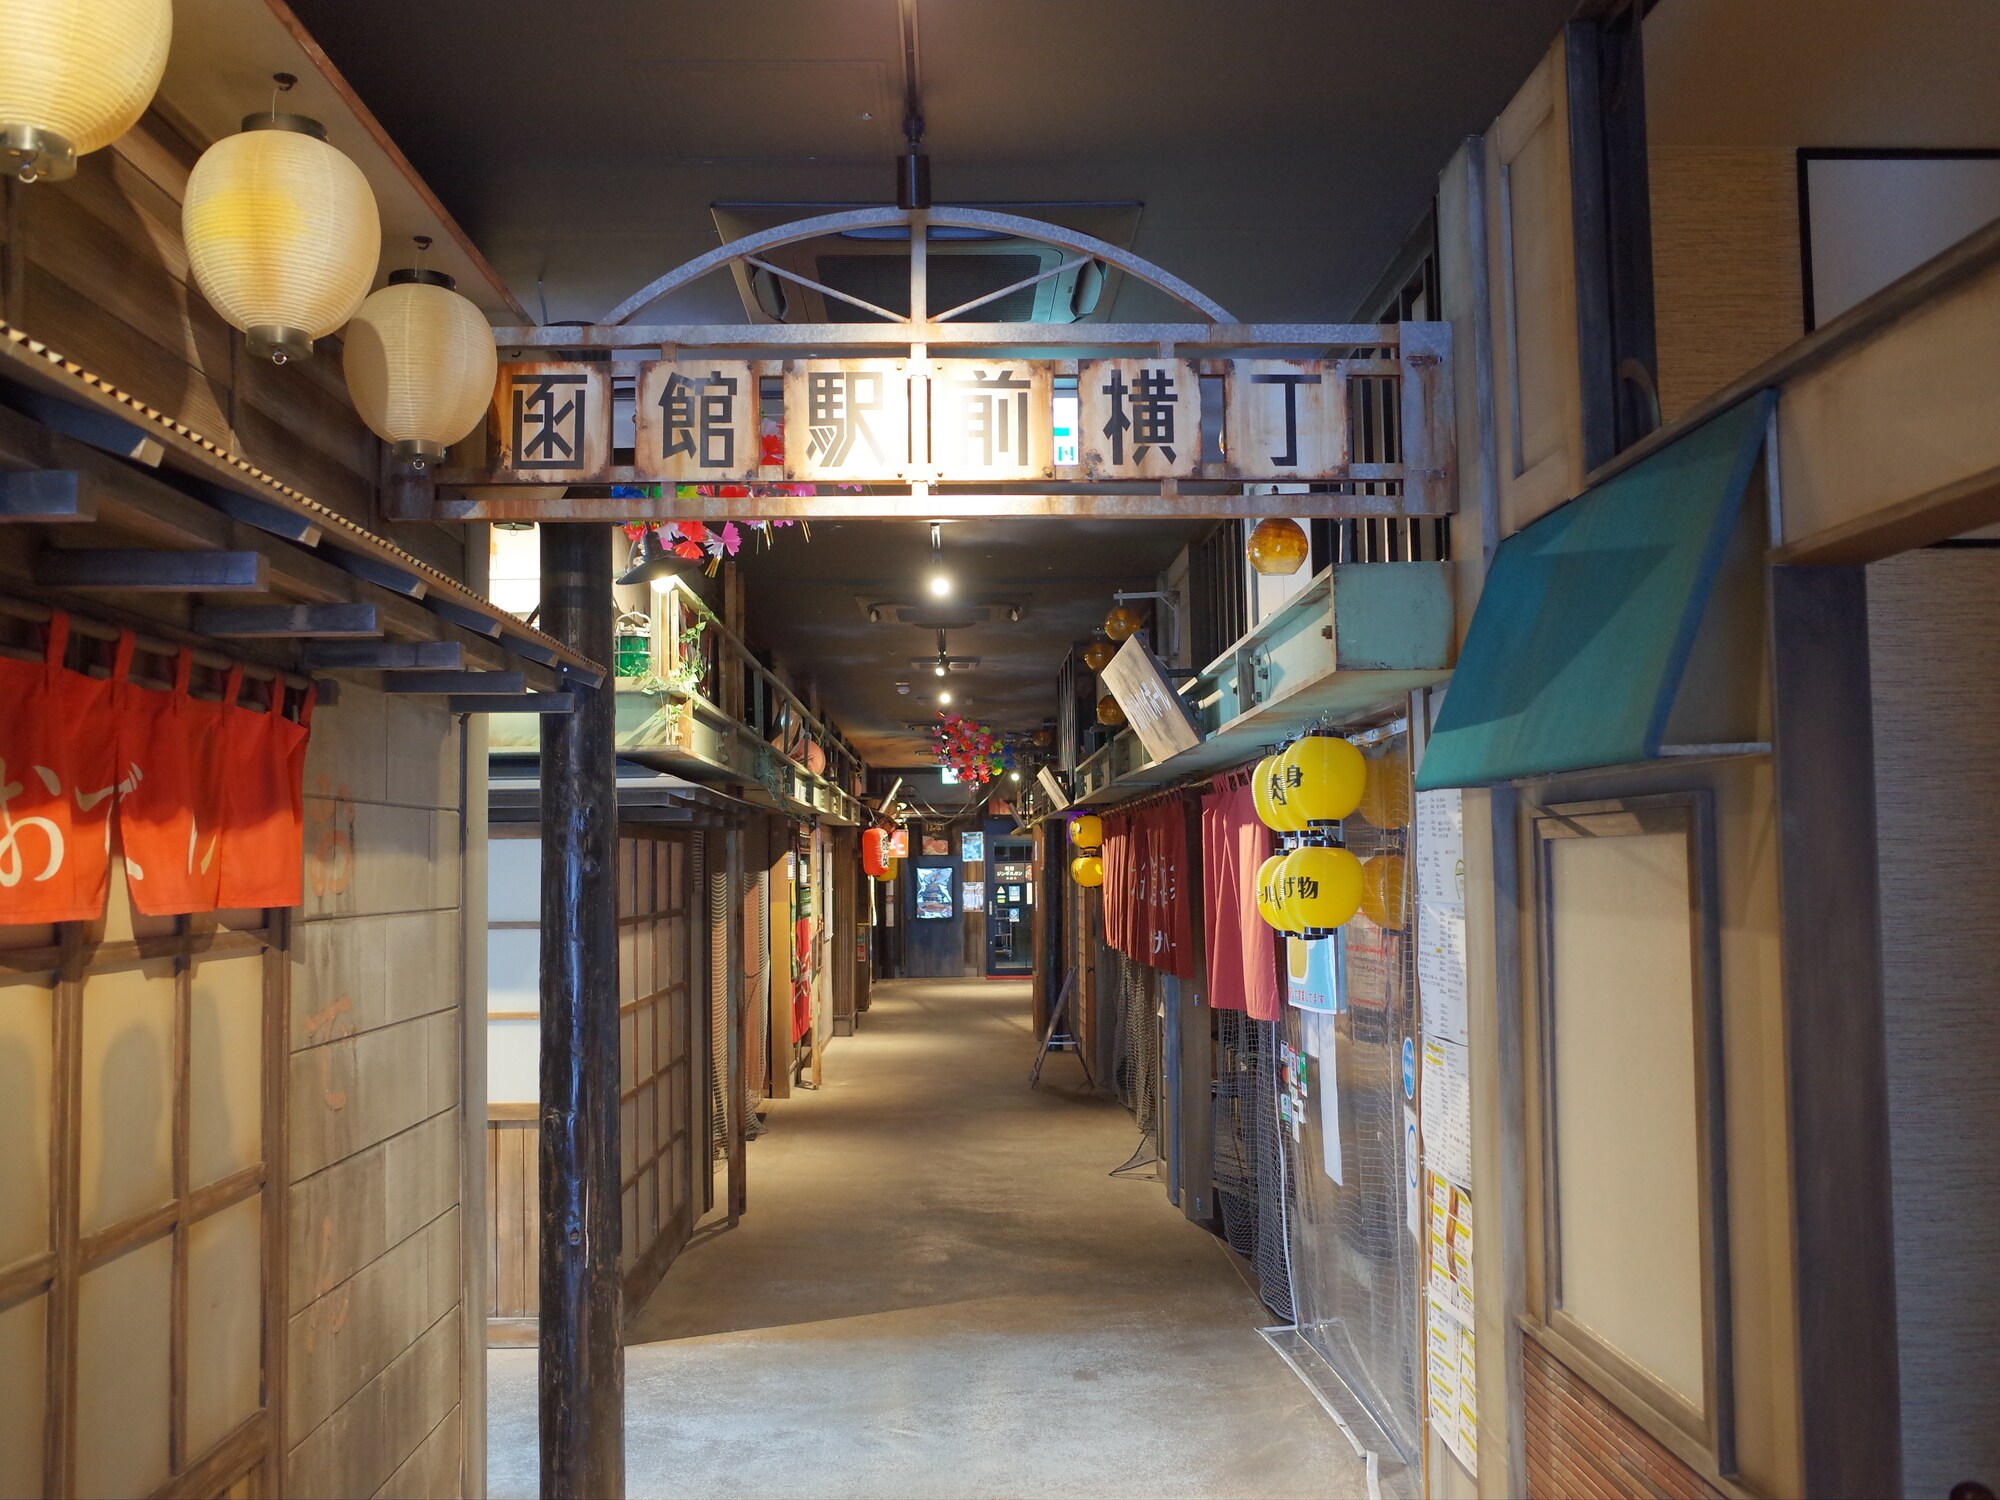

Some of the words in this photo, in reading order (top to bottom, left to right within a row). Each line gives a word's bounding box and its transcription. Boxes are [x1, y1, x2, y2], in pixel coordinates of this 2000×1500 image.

[511, 368, 1322, 470] 函館駅前横丁
